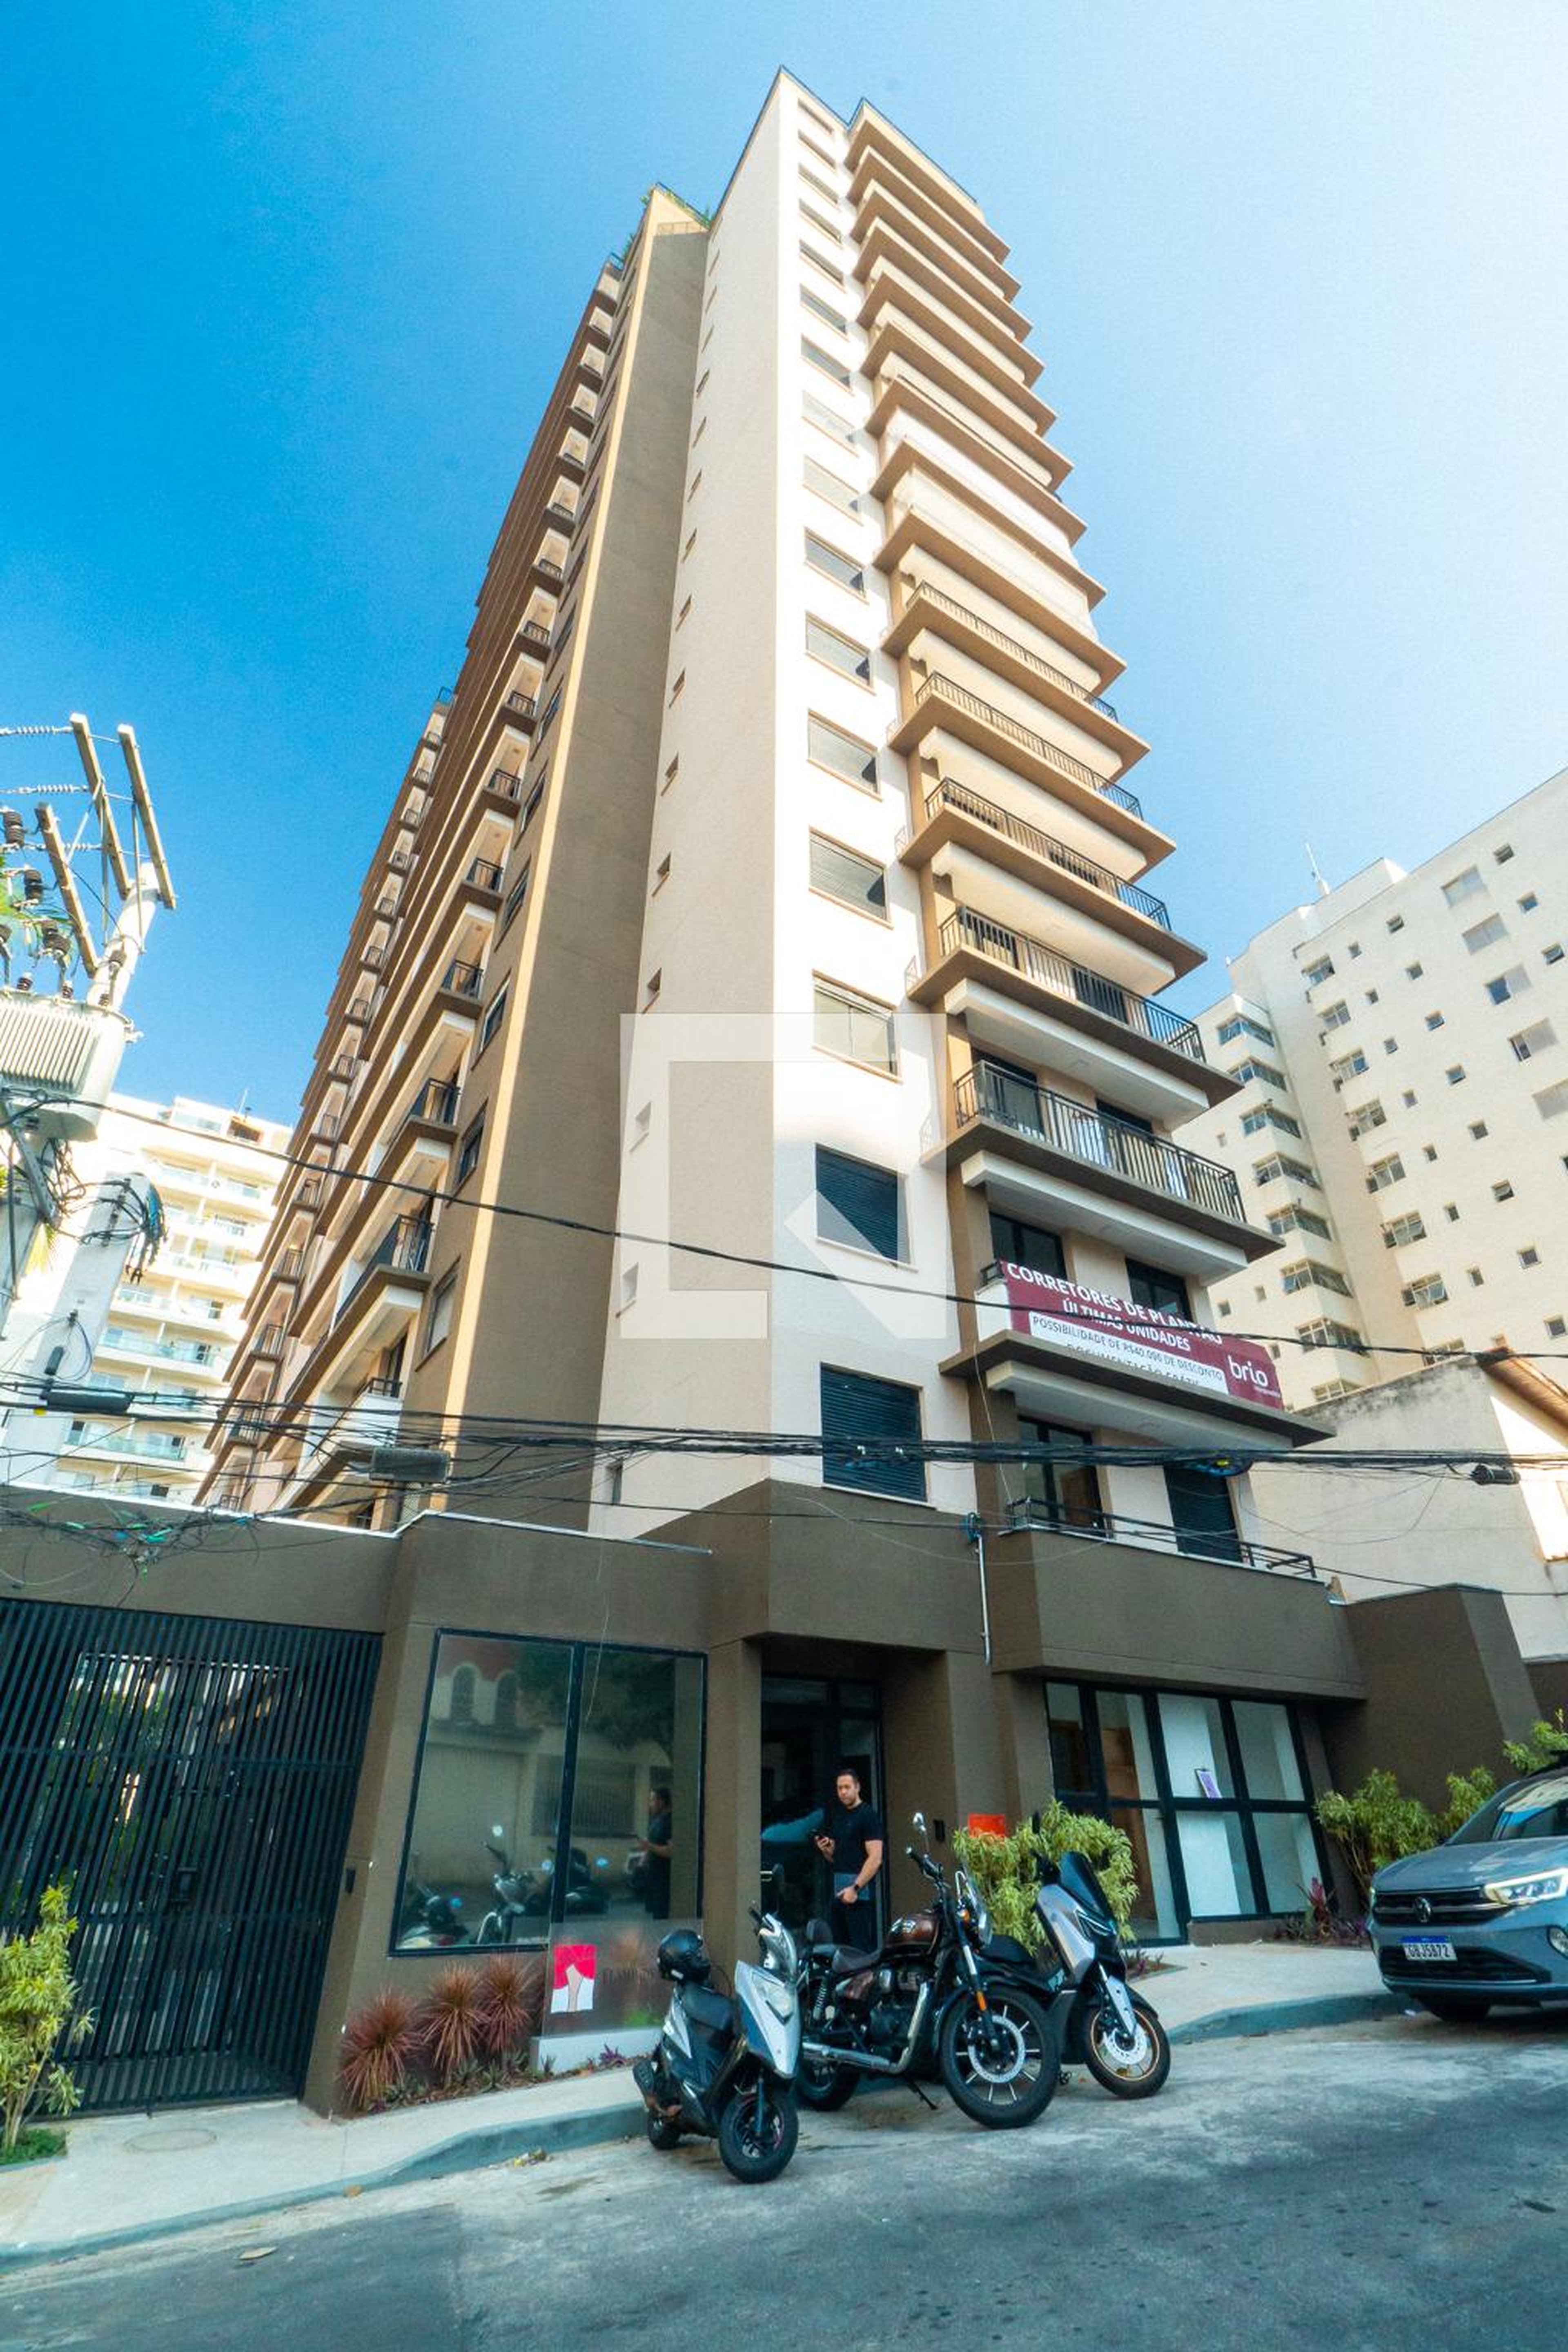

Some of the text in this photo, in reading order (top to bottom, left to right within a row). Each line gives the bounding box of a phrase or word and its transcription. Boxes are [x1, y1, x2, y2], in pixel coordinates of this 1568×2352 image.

[1007, 1263, 1122, 1312] CORRETORES
[1123, 1301, 1148, 1320] DE
[1033, 1316, 1106, 1346] POSSIBILIDADE
[1108, 1339, 1120, 1350] DE
[1164, 1357, 1175, 1366] DE
[1176, 1359, 1223, 1381] DESCONTO
[1127, 1324, 1191, 1352] UNIDADES
[1228, 1355, 1268, 1387] brio
